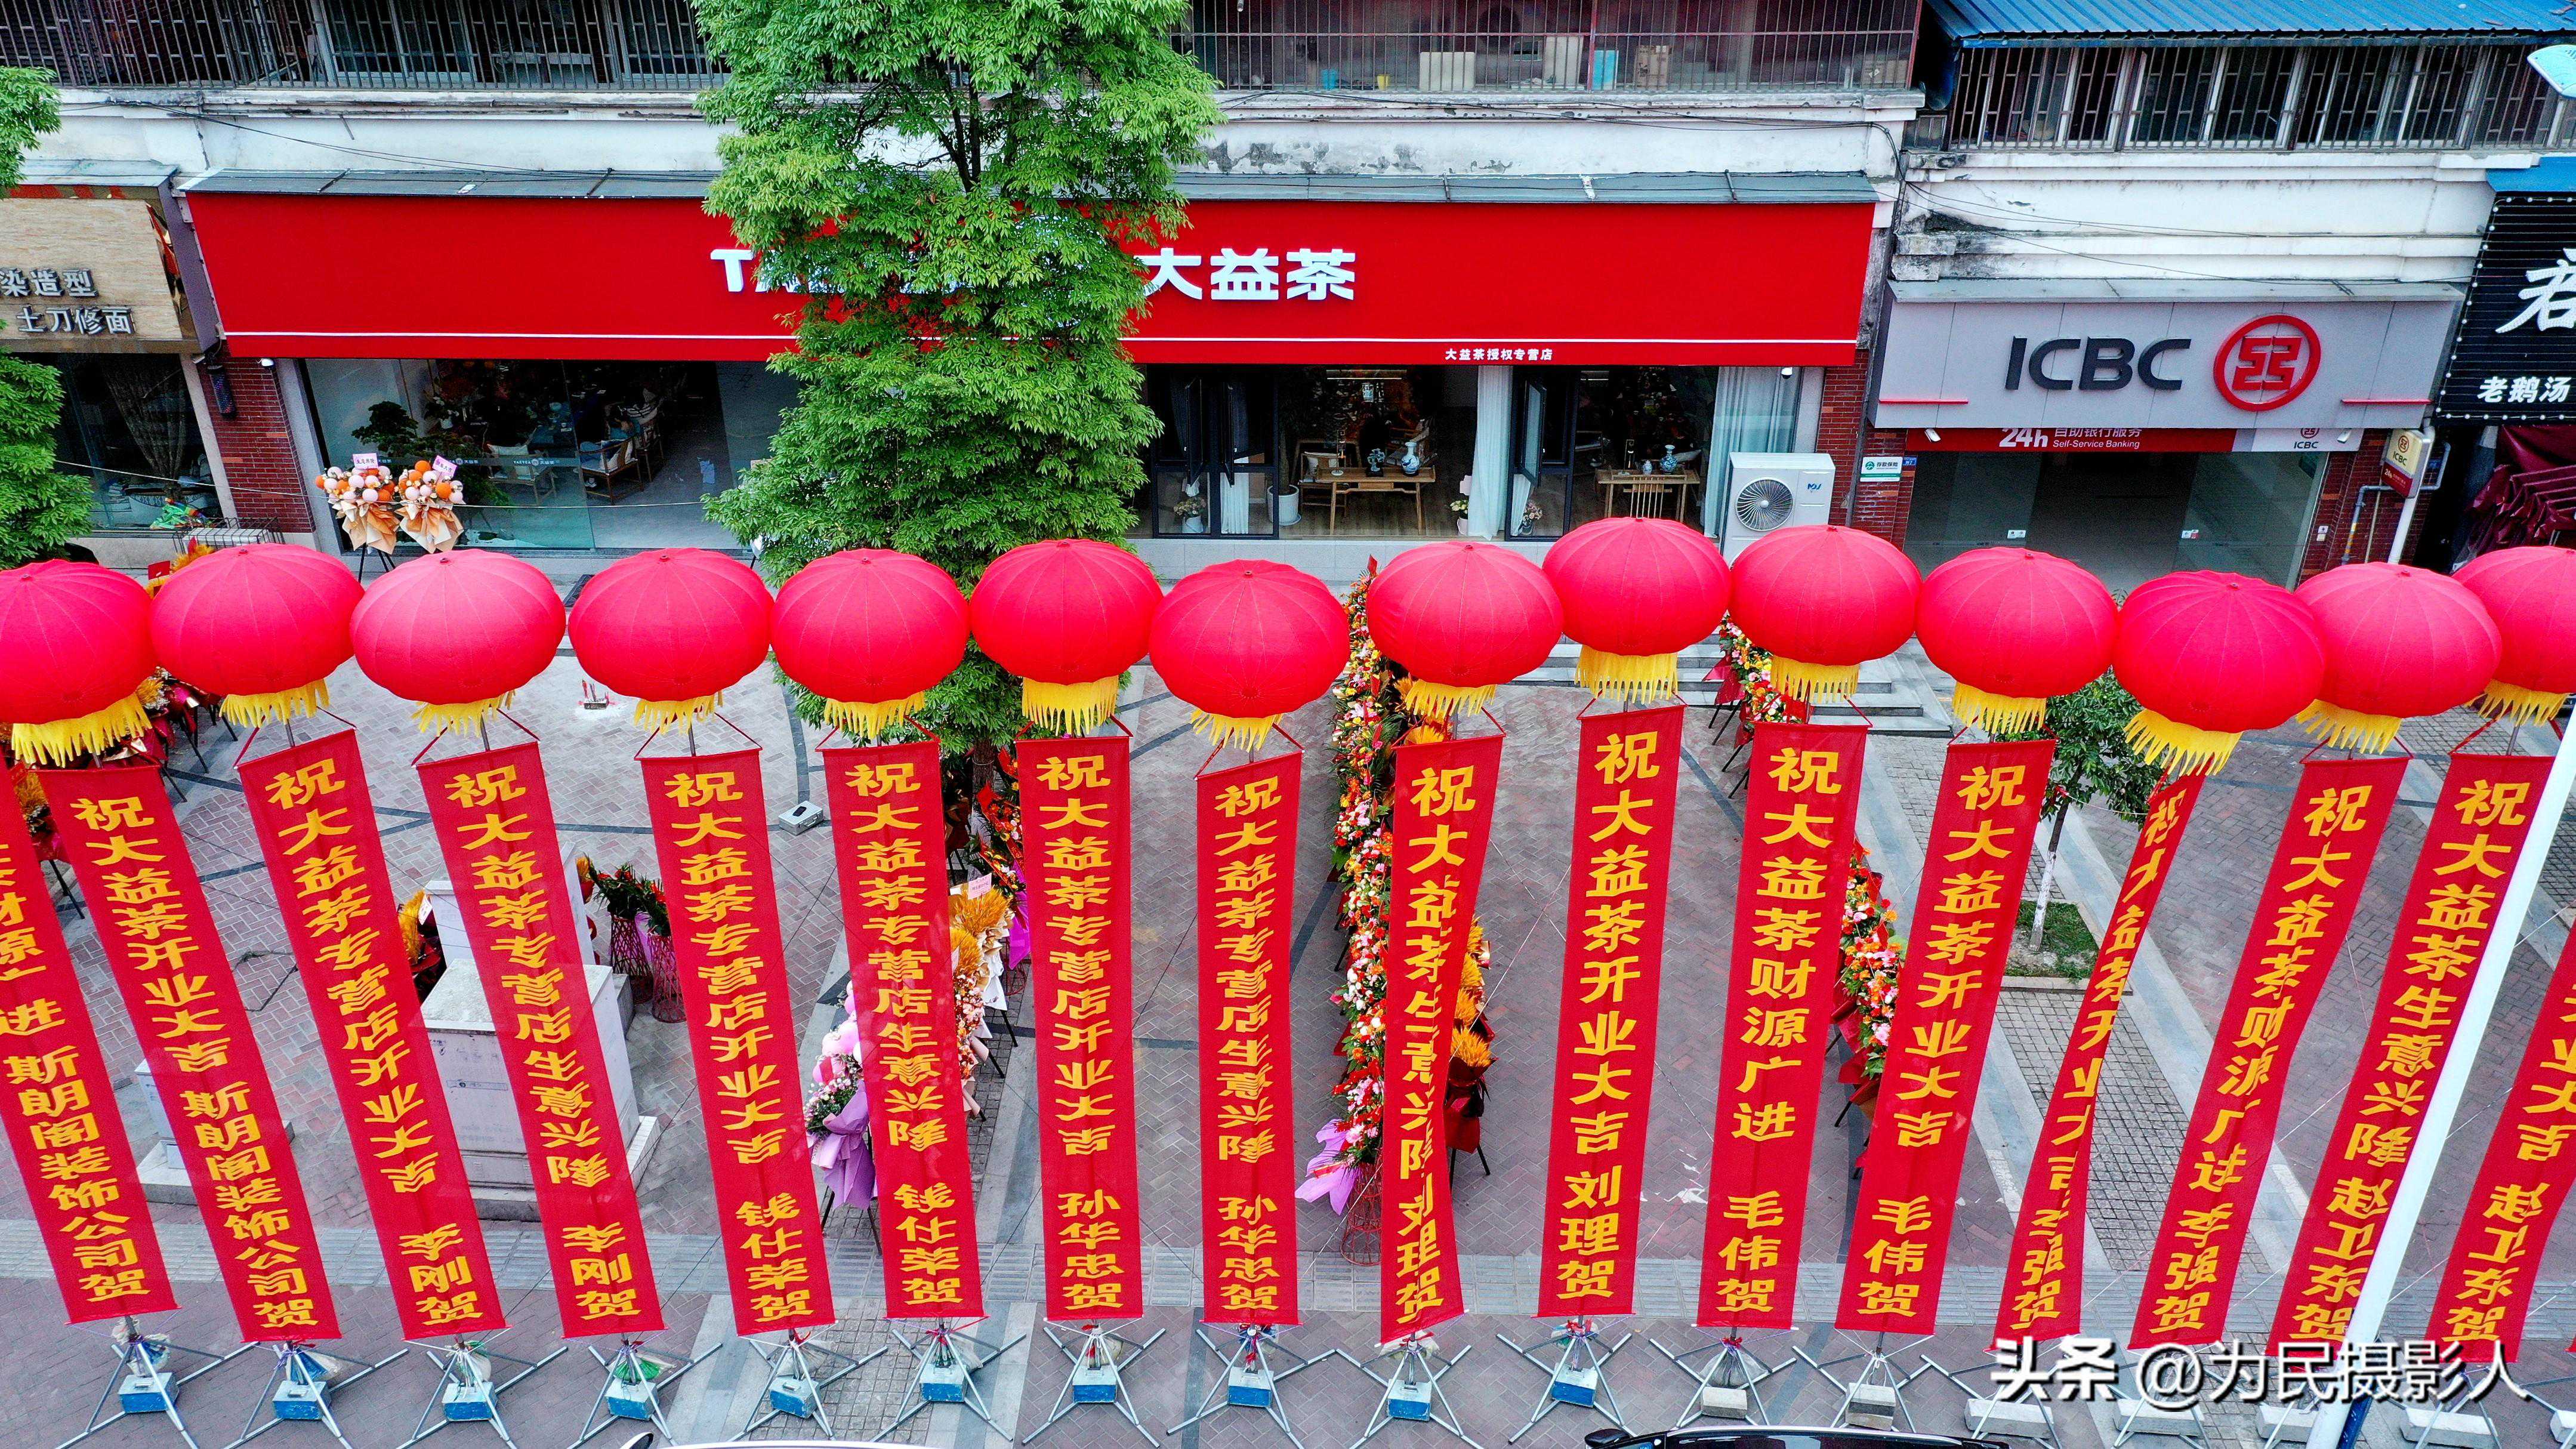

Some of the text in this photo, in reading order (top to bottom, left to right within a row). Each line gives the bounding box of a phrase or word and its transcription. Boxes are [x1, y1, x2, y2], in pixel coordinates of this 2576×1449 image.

[1134, 246, 1356, 302] 大益茶
[1444, 347, 1554, 362] 大益茶授权专营店
[2004, 335, 2192, 391] ICBC
[2477, 376, 2572, 403] 老鹅汤
[1998, 428, 2049, 448] 24h
[2053, 440, 2140, 449] Self-Service Banking
[2293, 441, 2319, 449] ICBC
[2392, 451, 2408, 466] ICBC
